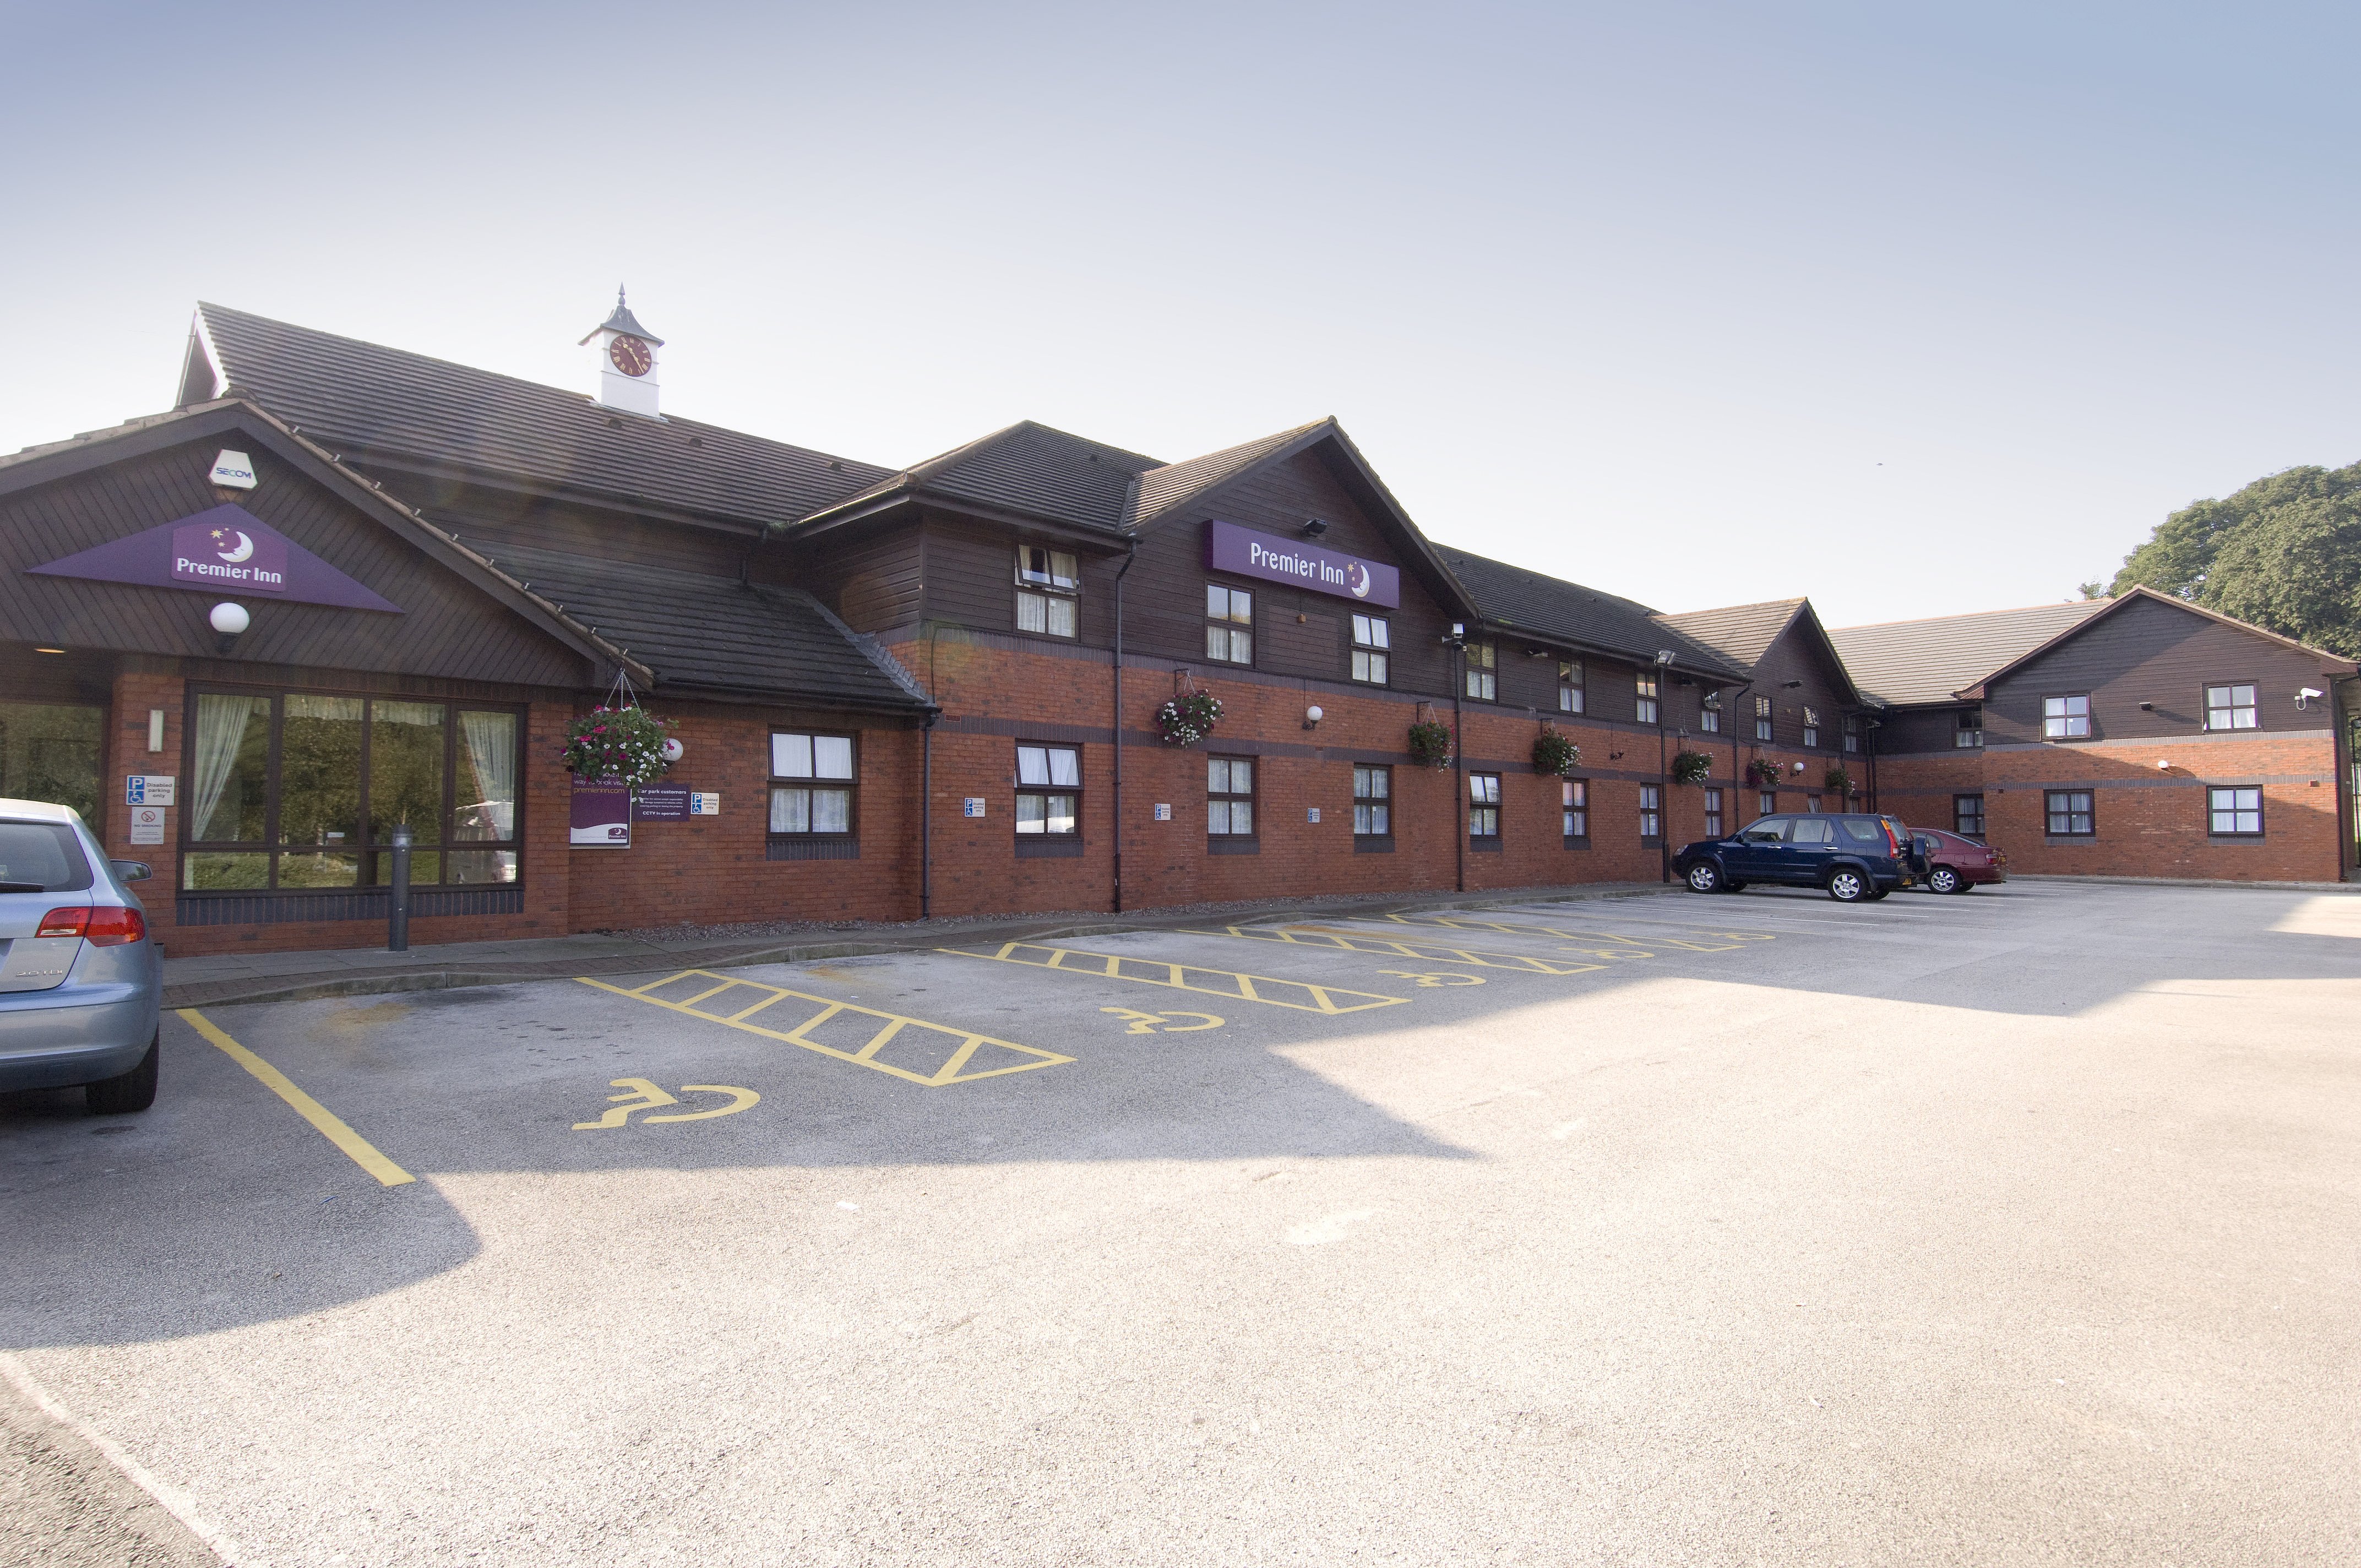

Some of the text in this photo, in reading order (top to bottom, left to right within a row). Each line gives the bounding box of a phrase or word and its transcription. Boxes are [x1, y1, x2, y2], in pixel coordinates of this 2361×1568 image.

[216, 467, 252, 479] SECOM
[177, 557, 282, 584] Premier Inn
[1251, 542, 1344, 585] Premier Inn
[132, 778, 143, 789] P
